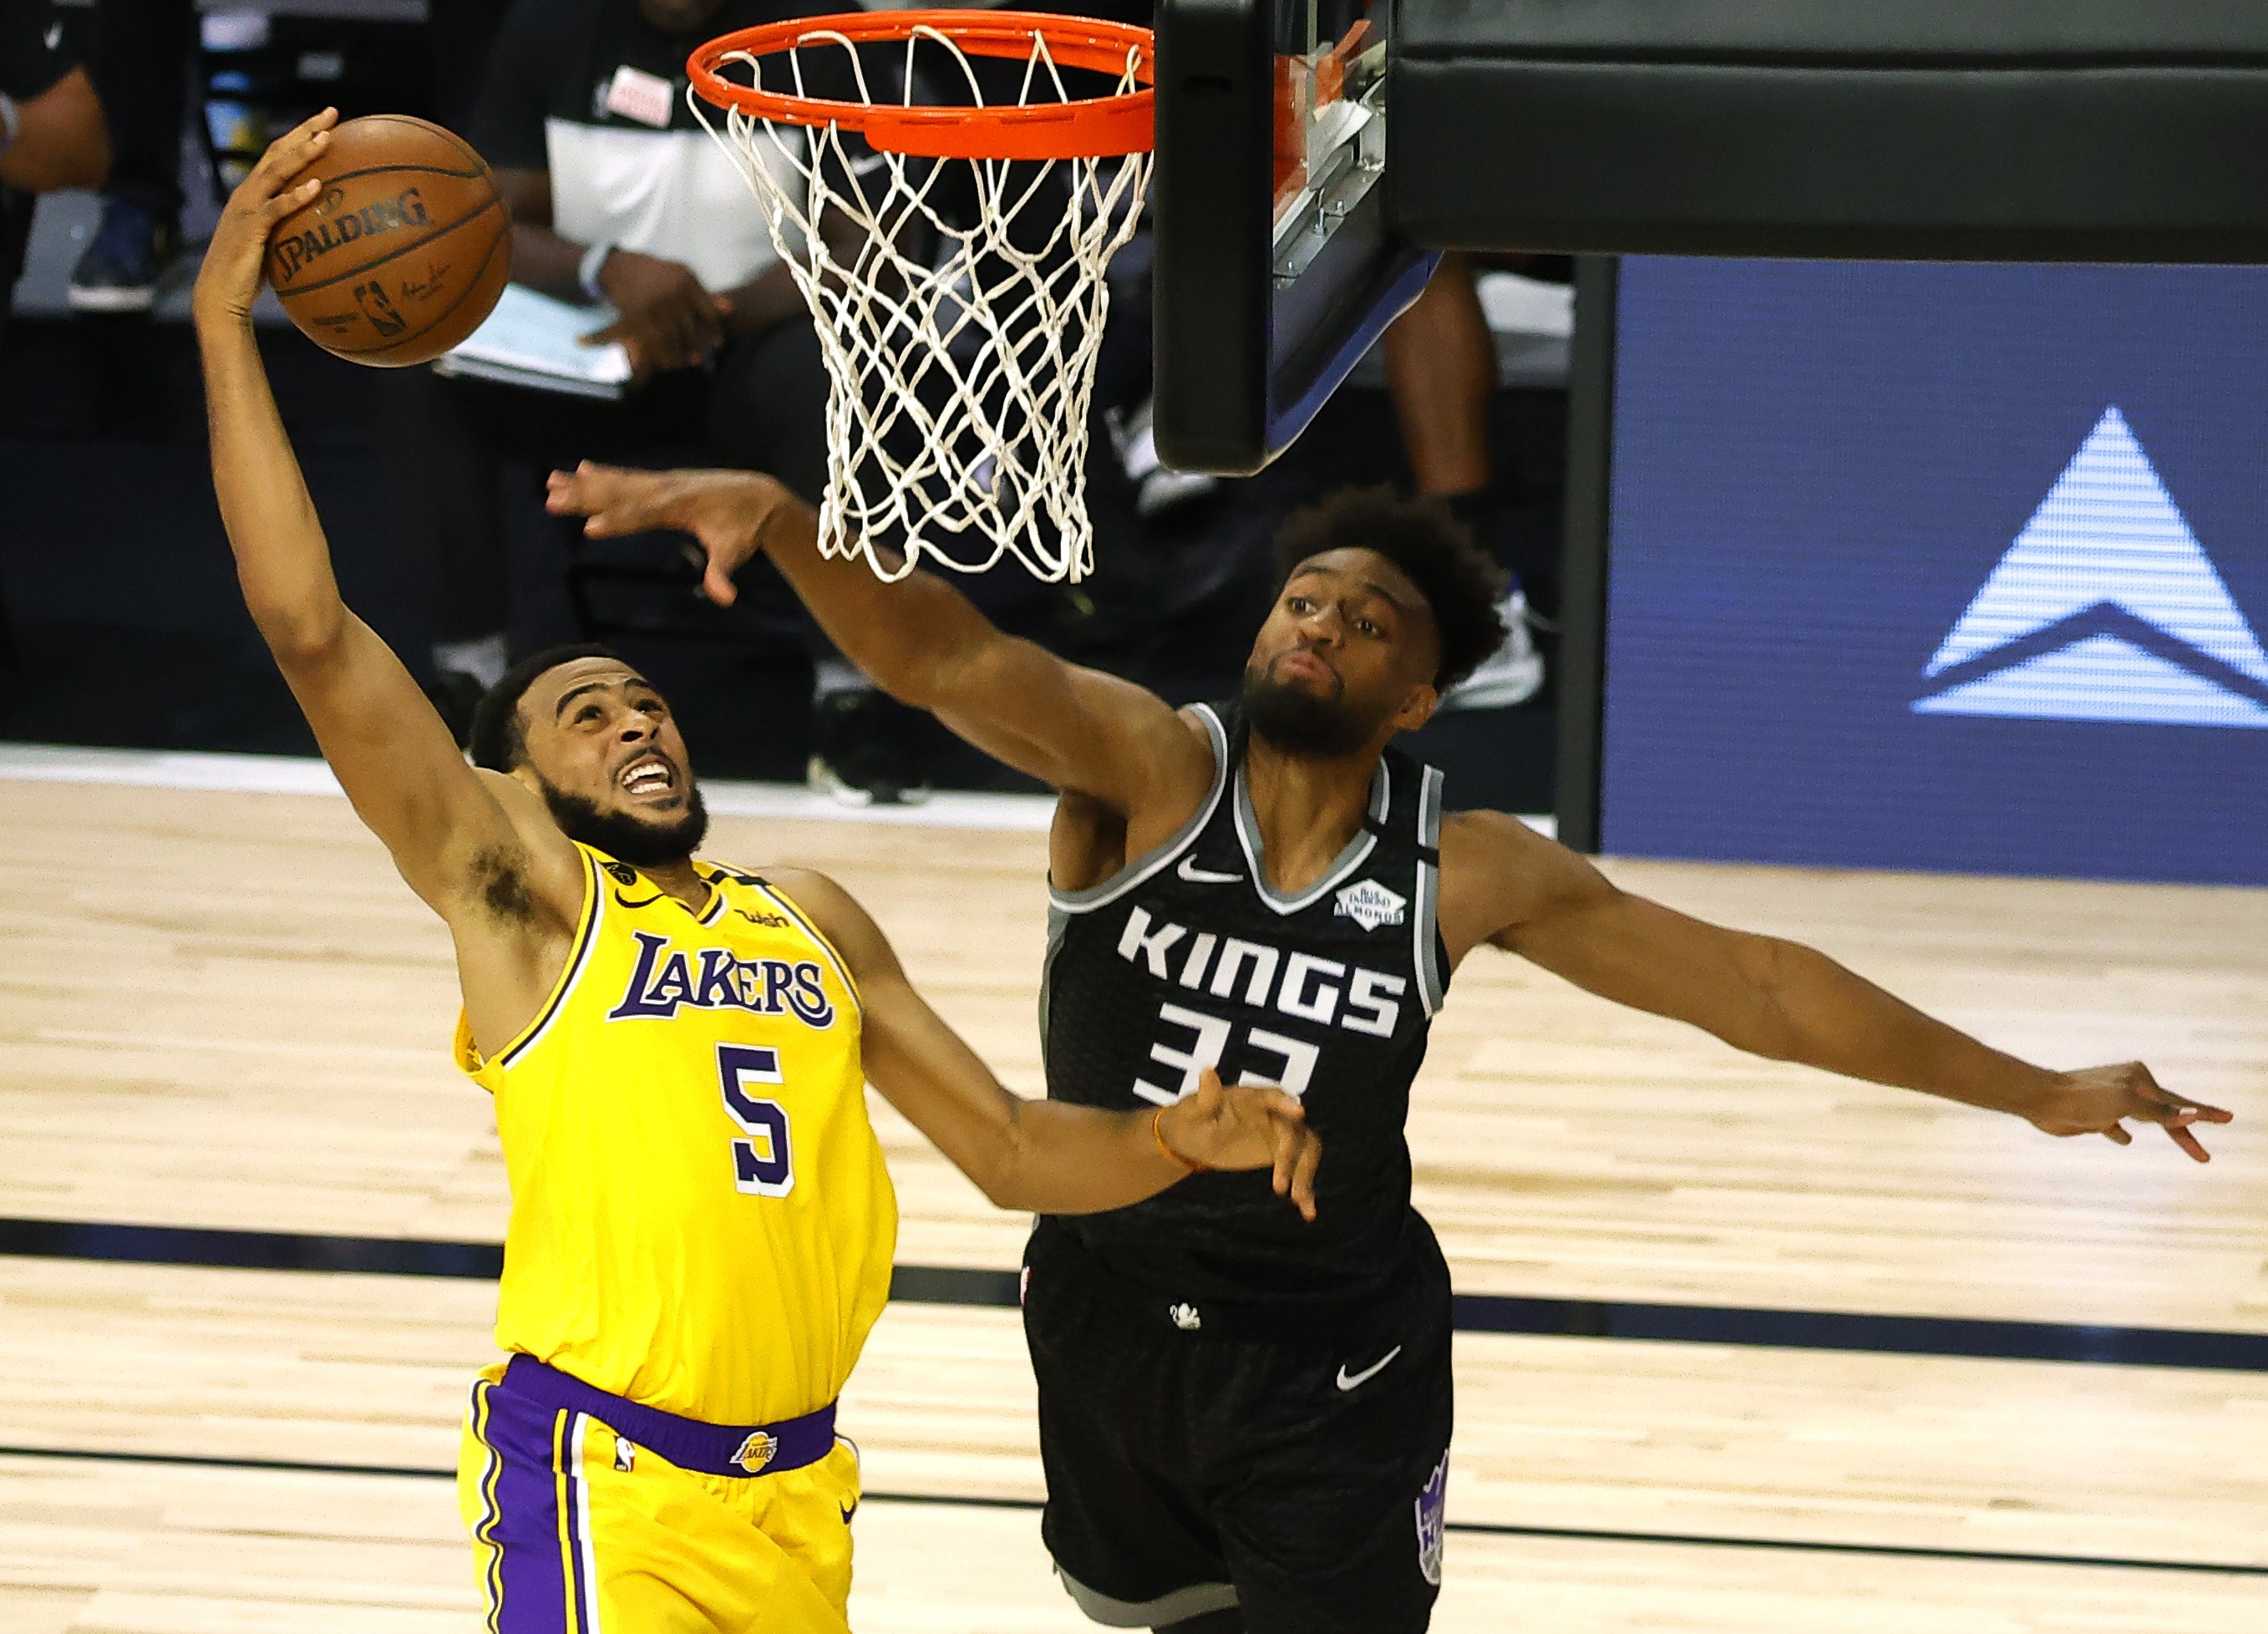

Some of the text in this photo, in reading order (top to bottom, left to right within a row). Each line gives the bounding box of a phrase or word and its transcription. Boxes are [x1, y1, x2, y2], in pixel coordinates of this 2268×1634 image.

[272, 186, 430, 284] SPALDING
[606, 931, 836, 1030] LAKERS
[1118, 905, 1407, 1038] KINGS
[716, 1043, 794, 1197] 5
